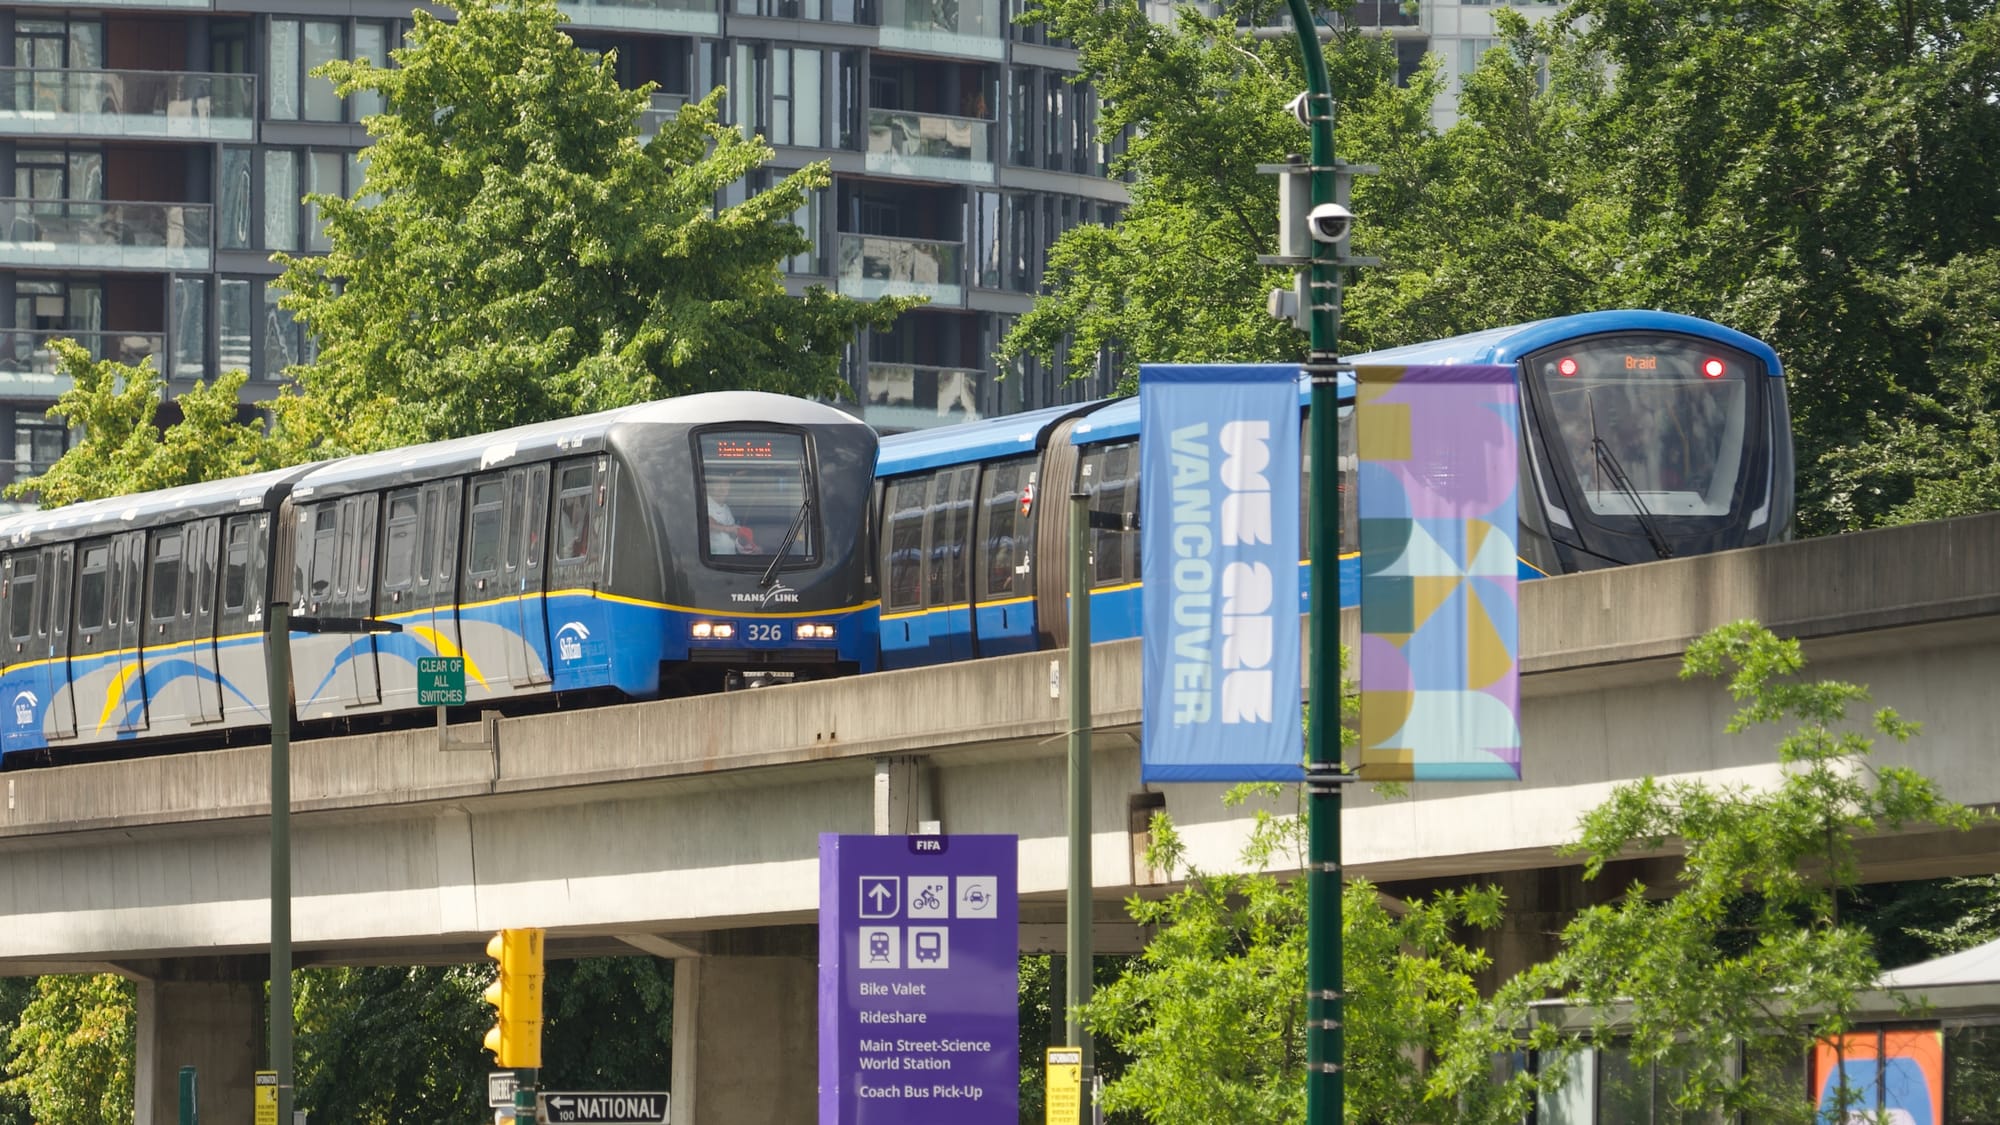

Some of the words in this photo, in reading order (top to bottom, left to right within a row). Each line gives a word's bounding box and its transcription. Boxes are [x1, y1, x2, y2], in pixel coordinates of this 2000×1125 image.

[1625, 355, 1657, 369] Braid
[1219, 420, 1272, 546] WE
[1170, 422, 1213, 725] VANCOUVER
[748, 624, 782, 641] 326
[1222, 561, 1273, 724] ARE
[420, 660, 447, 673] CLEAR
[450, 660, 462, 672] OF
[434, 675, 449, 687] ALL
[421, 690, 463, 703] SWITCHES
[916, 840, 941, 850] FIFA
[860, 982, 889, 996] Bike
[892, 982, 926, 996] Valet
[860, 1010, 927, 1024] Rideshare
[860, 1039, 893, 1052] Main
[896, 1039, 991, 1052] Street-Science
[859, 1057, 900, 1070] World
[903, 1057, 951, 1070] Station
[860, 1085, 900, 1098] Coach
[904, 1085, 930, 1098] Bus
[933, 1085, 983, 1101] Pick-Up
[559, 1111, 575, 1121] 100
[577, 1097, 661, 1119] NATIONAL
